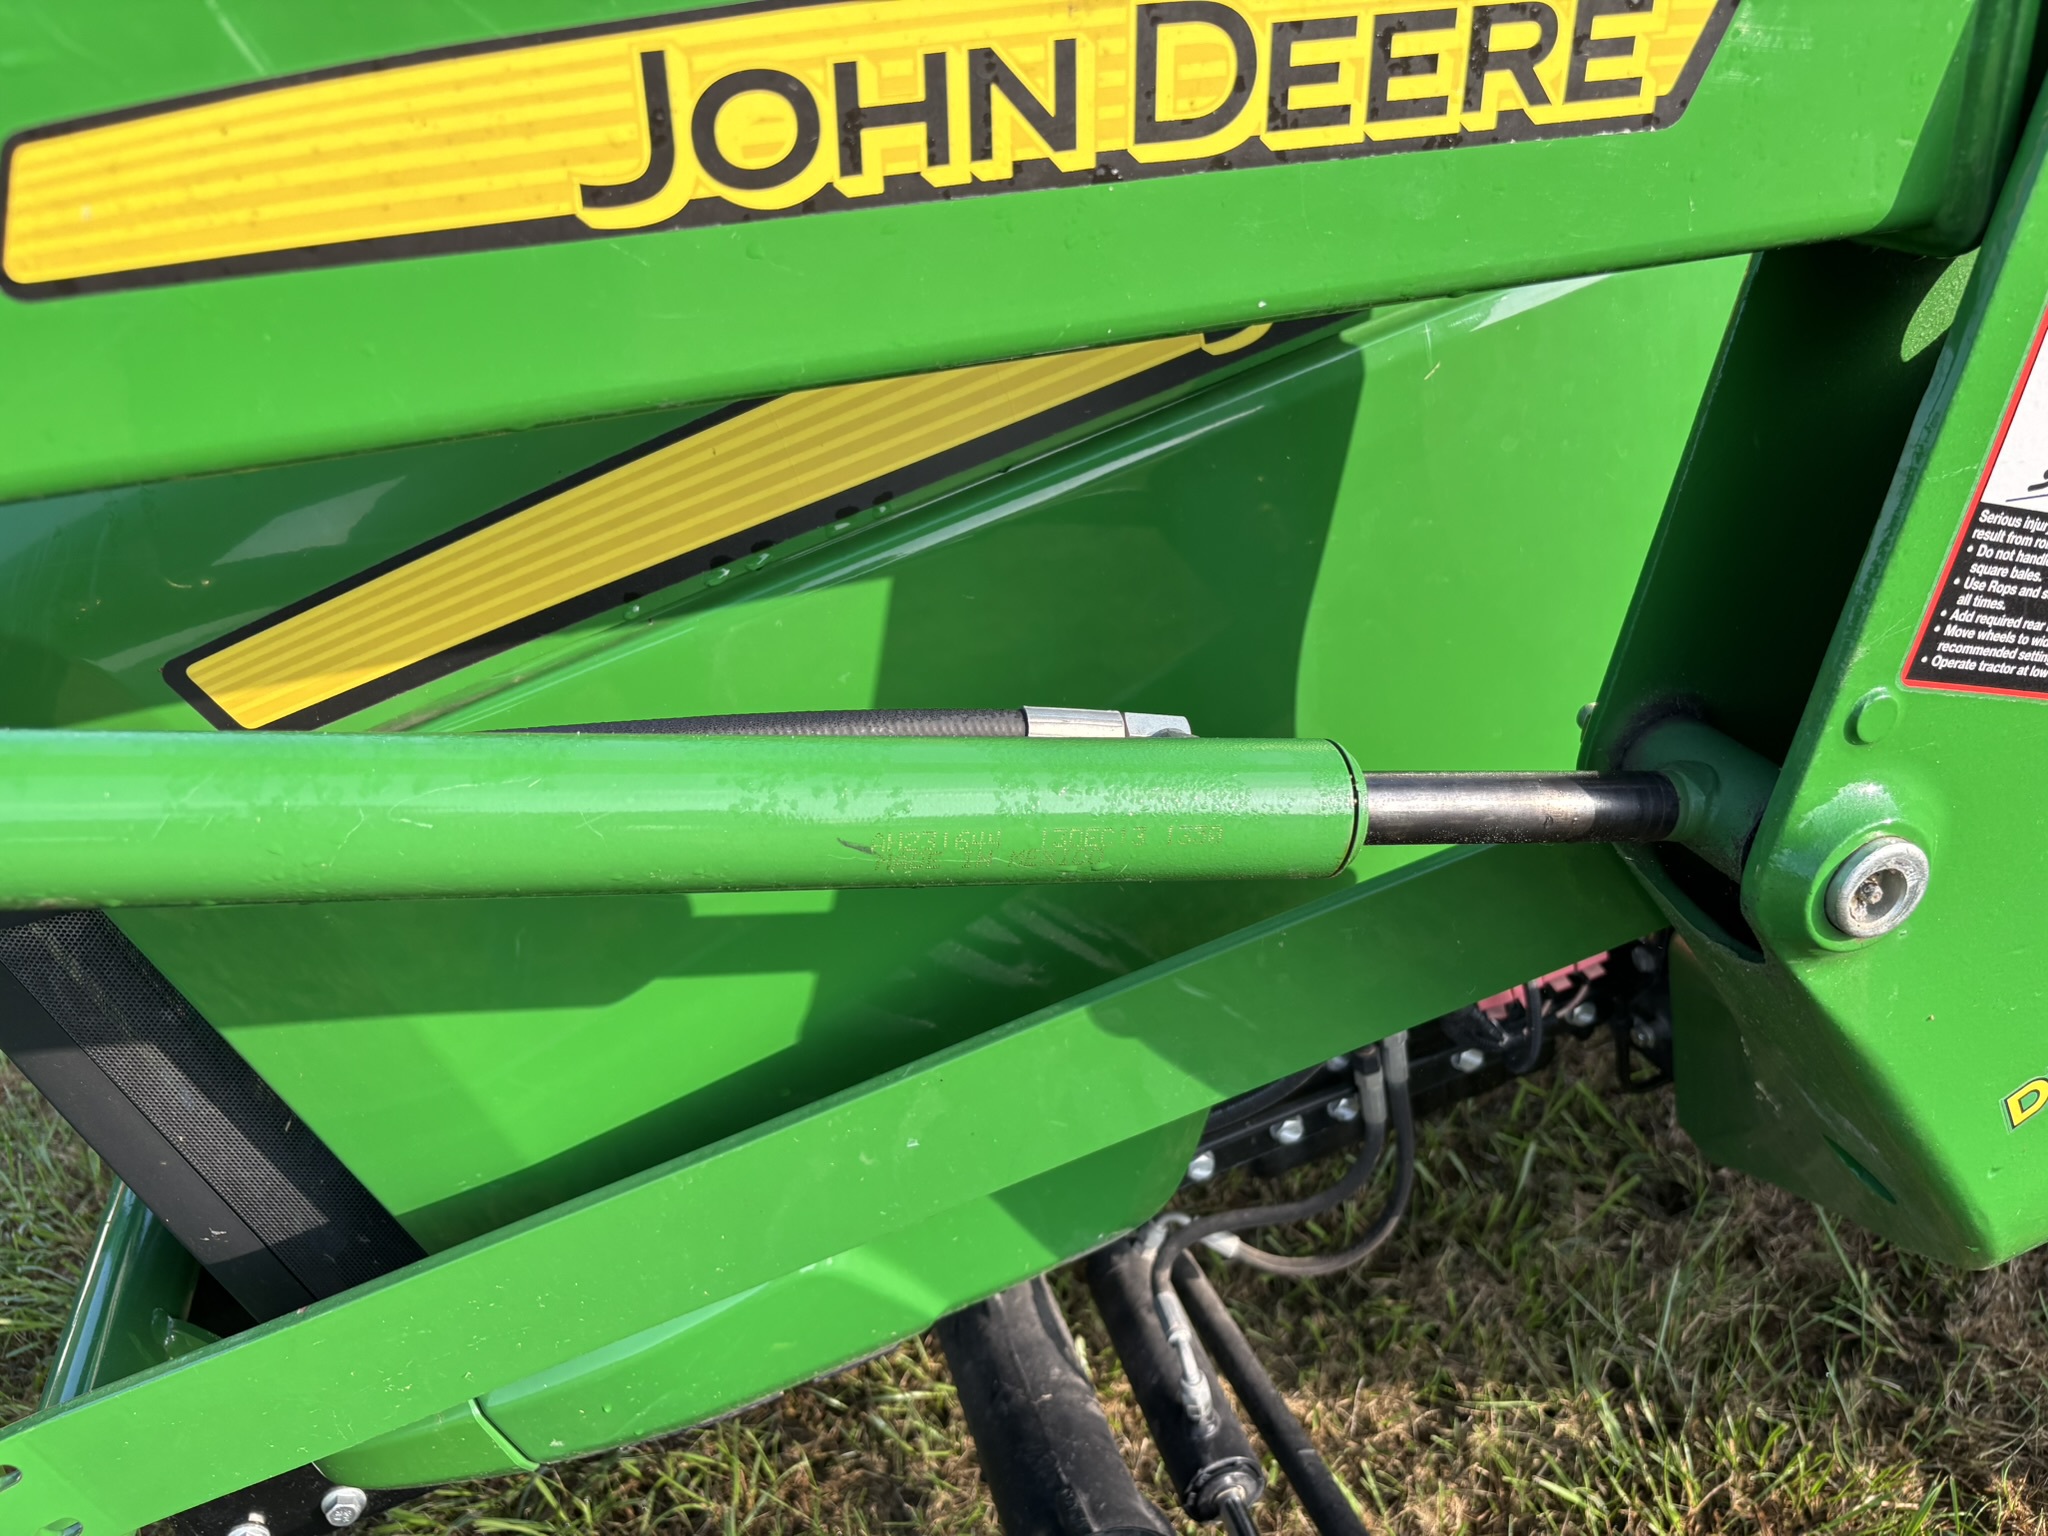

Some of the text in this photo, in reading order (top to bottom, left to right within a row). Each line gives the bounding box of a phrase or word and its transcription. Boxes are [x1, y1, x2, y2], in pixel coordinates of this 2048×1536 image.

[579, 0, 1657, 210] JOHN DEERE
[1978, 509, 2023, 528] Serious
[1971, 528, 2006, 543] result
[2006, 531, 2034, 547] from
[1976, 543, 1994, 559] Do
[1994, 548, 2016, 561] not
[1969, 562, 2042, 582] square bales.
[1963, 575, 1987, 591] Use
[1987, 579, 2018, 597] Rops
[2018, 586, 2042, 599] and
[1956, 592, 2006, 611] all times.
[1949, 608, 1976, 623] Add
[1974, 612, 2023, 629] required
[2022, 620, 2046, 632] rear
[1943, 623, 1976, 639] Move
[1976, 629, 2016, 644] wheels
[2017, 633, 2030, 645] to
[1936, 641, 2019, 660] recommended
[1931, 654, 1977, 671] Operate
[1977, 660, 2017, 675] tractor
[2016, 665, 2030, 677] at
